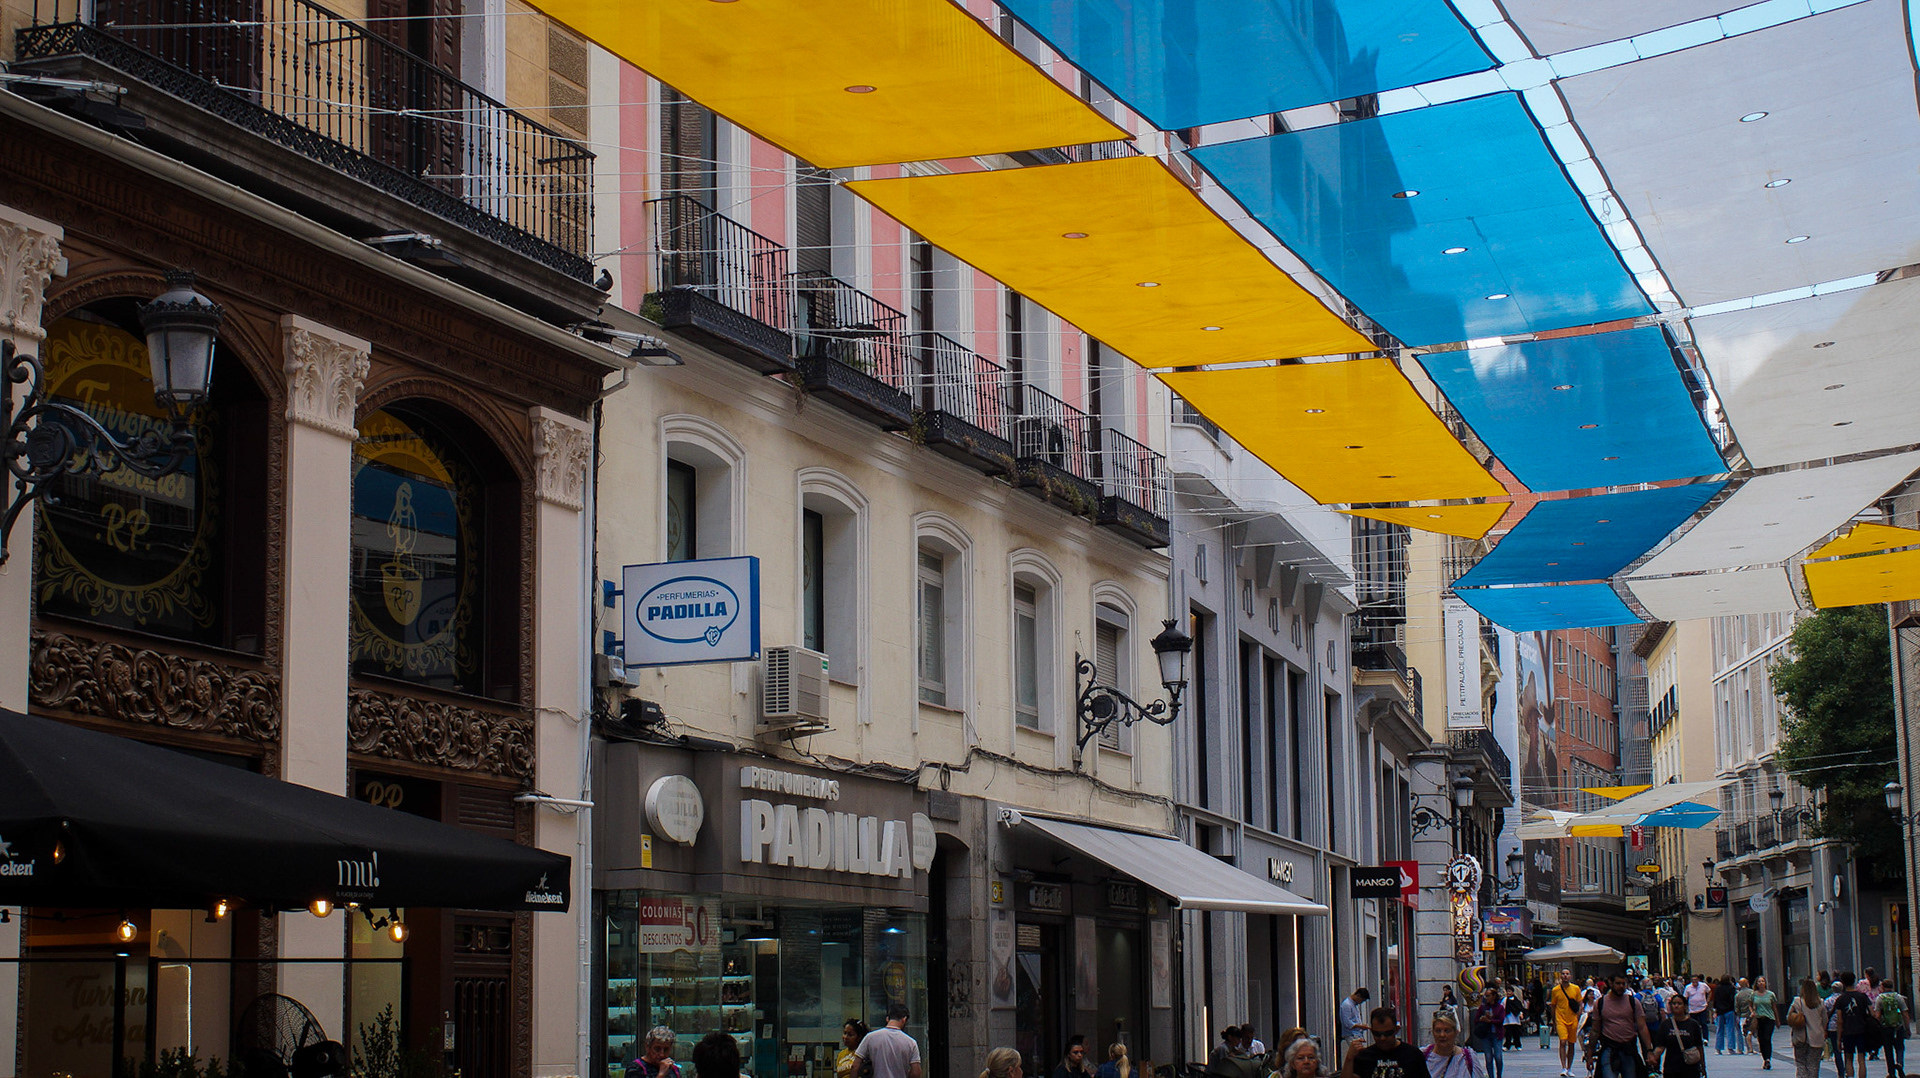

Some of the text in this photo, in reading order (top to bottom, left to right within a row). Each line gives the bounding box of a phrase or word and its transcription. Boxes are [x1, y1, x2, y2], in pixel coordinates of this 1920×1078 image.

[660, 590, 715, 601] PERFUMERIAS
[648, 601, 728, 621] PADILLA
[741, 766, 840, 801] PERFUMERIAS
[741, 798, 912, 879] PADILLA
[337, 850, 380, 888] mu!
[1269, 858, 1294, 883] MANGO
[1355, 877, 1395, 887] MANGO
[524, 890, 564, 904] Heineken
[642, 905, 682, 918] COLONIAS
[685, 906, 709, 946] 50
[643, 933, 682, 945] DESCUENTOS
